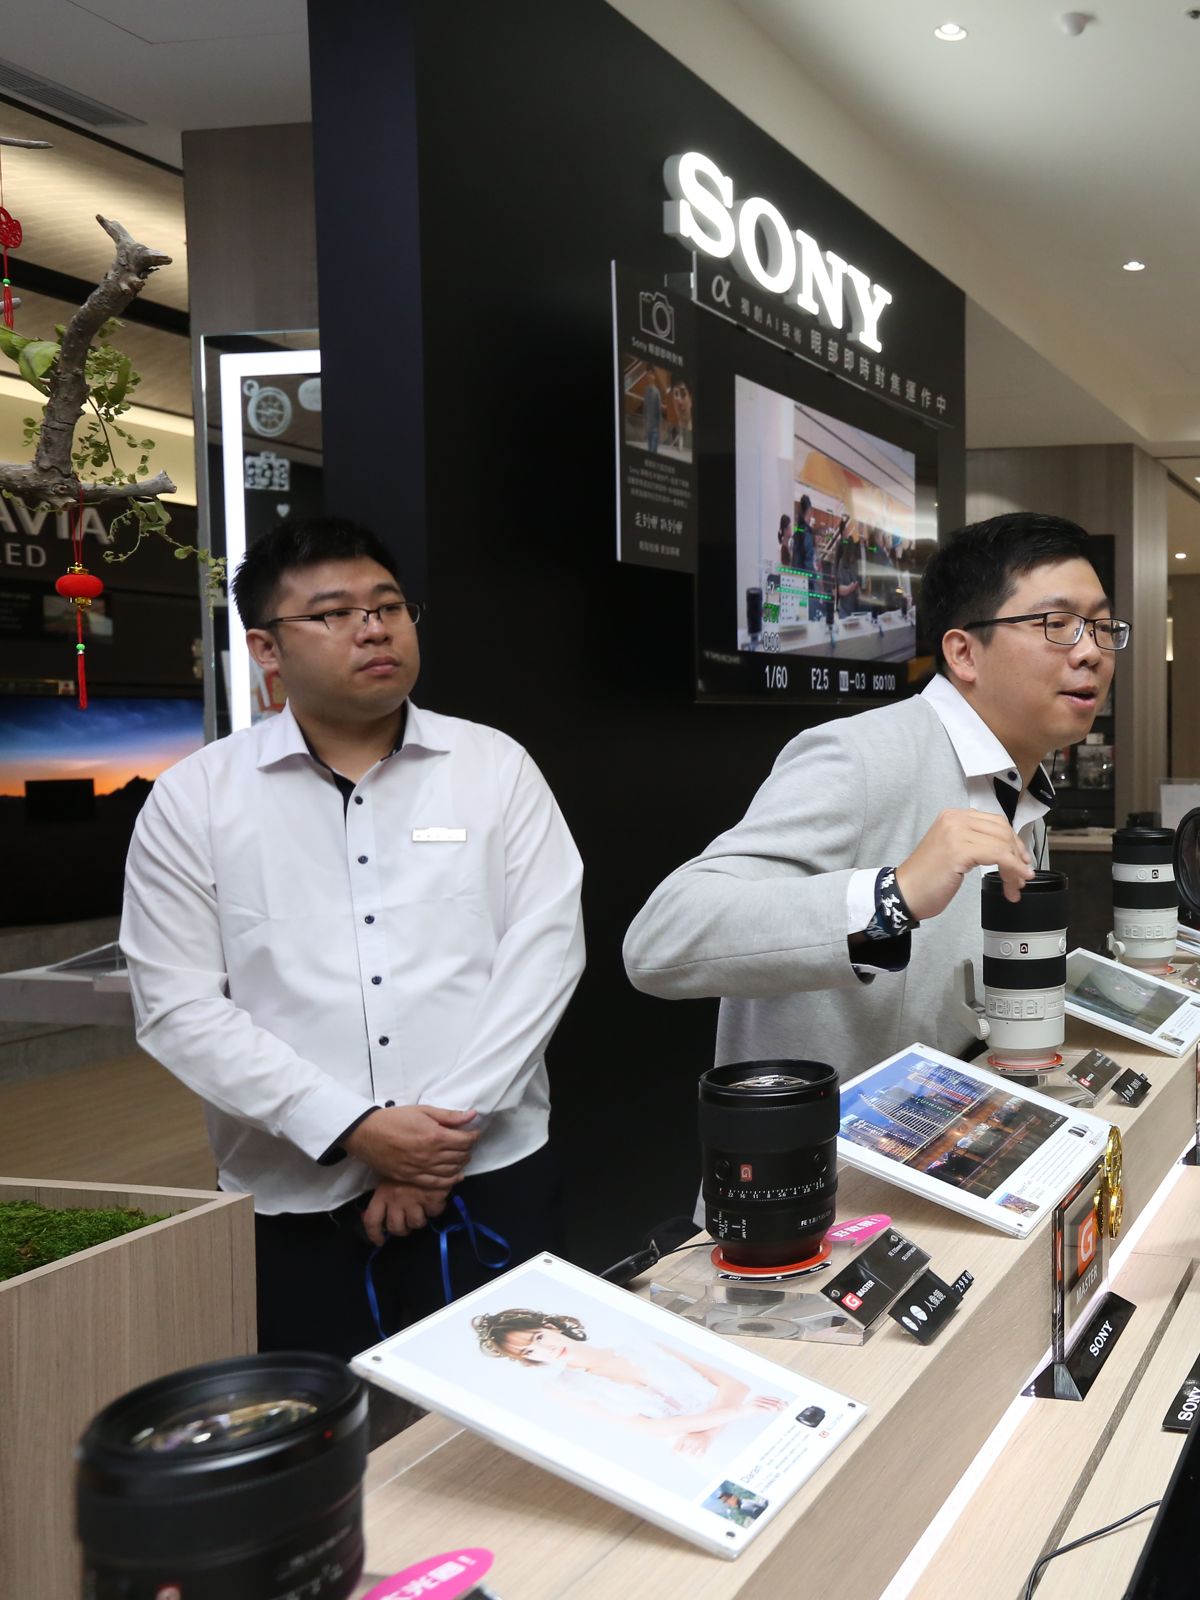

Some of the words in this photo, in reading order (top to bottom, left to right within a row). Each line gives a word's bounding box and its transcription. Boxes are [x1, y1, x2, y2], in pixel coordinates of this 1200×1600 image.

[668, 151, 893, 354] SONY
[0, 542, 48, 568] ED
[764, 665, 788, 689] 1/60
[810, 668, 830, 690] F2.5
[1080, 1216, 1094, 1264] G
[845, 1293, 859, 1308] G
[855, 1279, 876, 1298] MASTER
[927, 1288, 947, 1313] 人像鏡
[1075, 1265, 1099, 1305] MASTER
[1089, 1319, 1114, 1358] SONY
